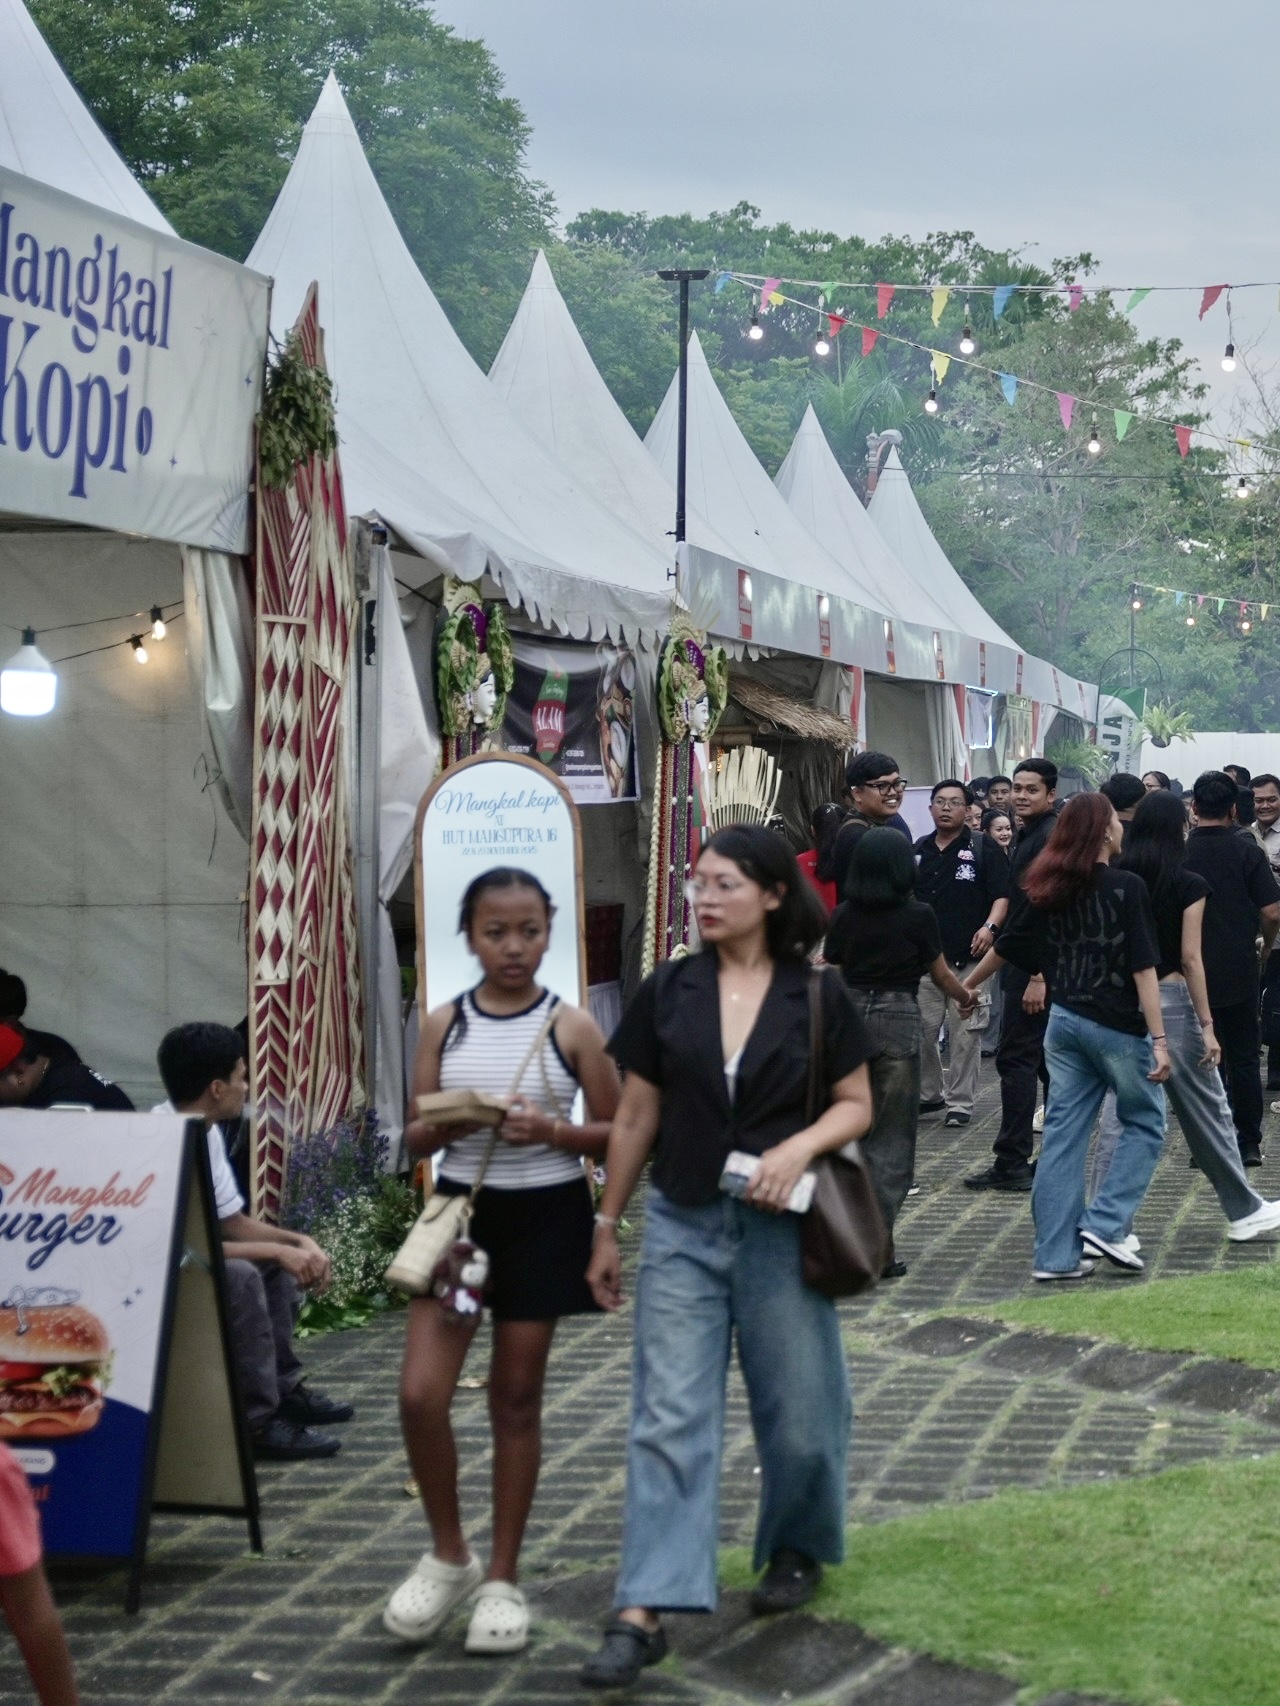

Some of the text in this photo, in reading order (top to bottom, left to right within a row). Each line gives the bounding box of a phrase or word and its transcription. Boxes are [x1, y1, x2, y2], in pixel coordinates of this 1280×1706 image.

[442, 827, 558, 845] HUT MANGUPURA 16
[6, 1167, 155, 1224] Mangkal
[0, 1210, 124, 1272] urger
